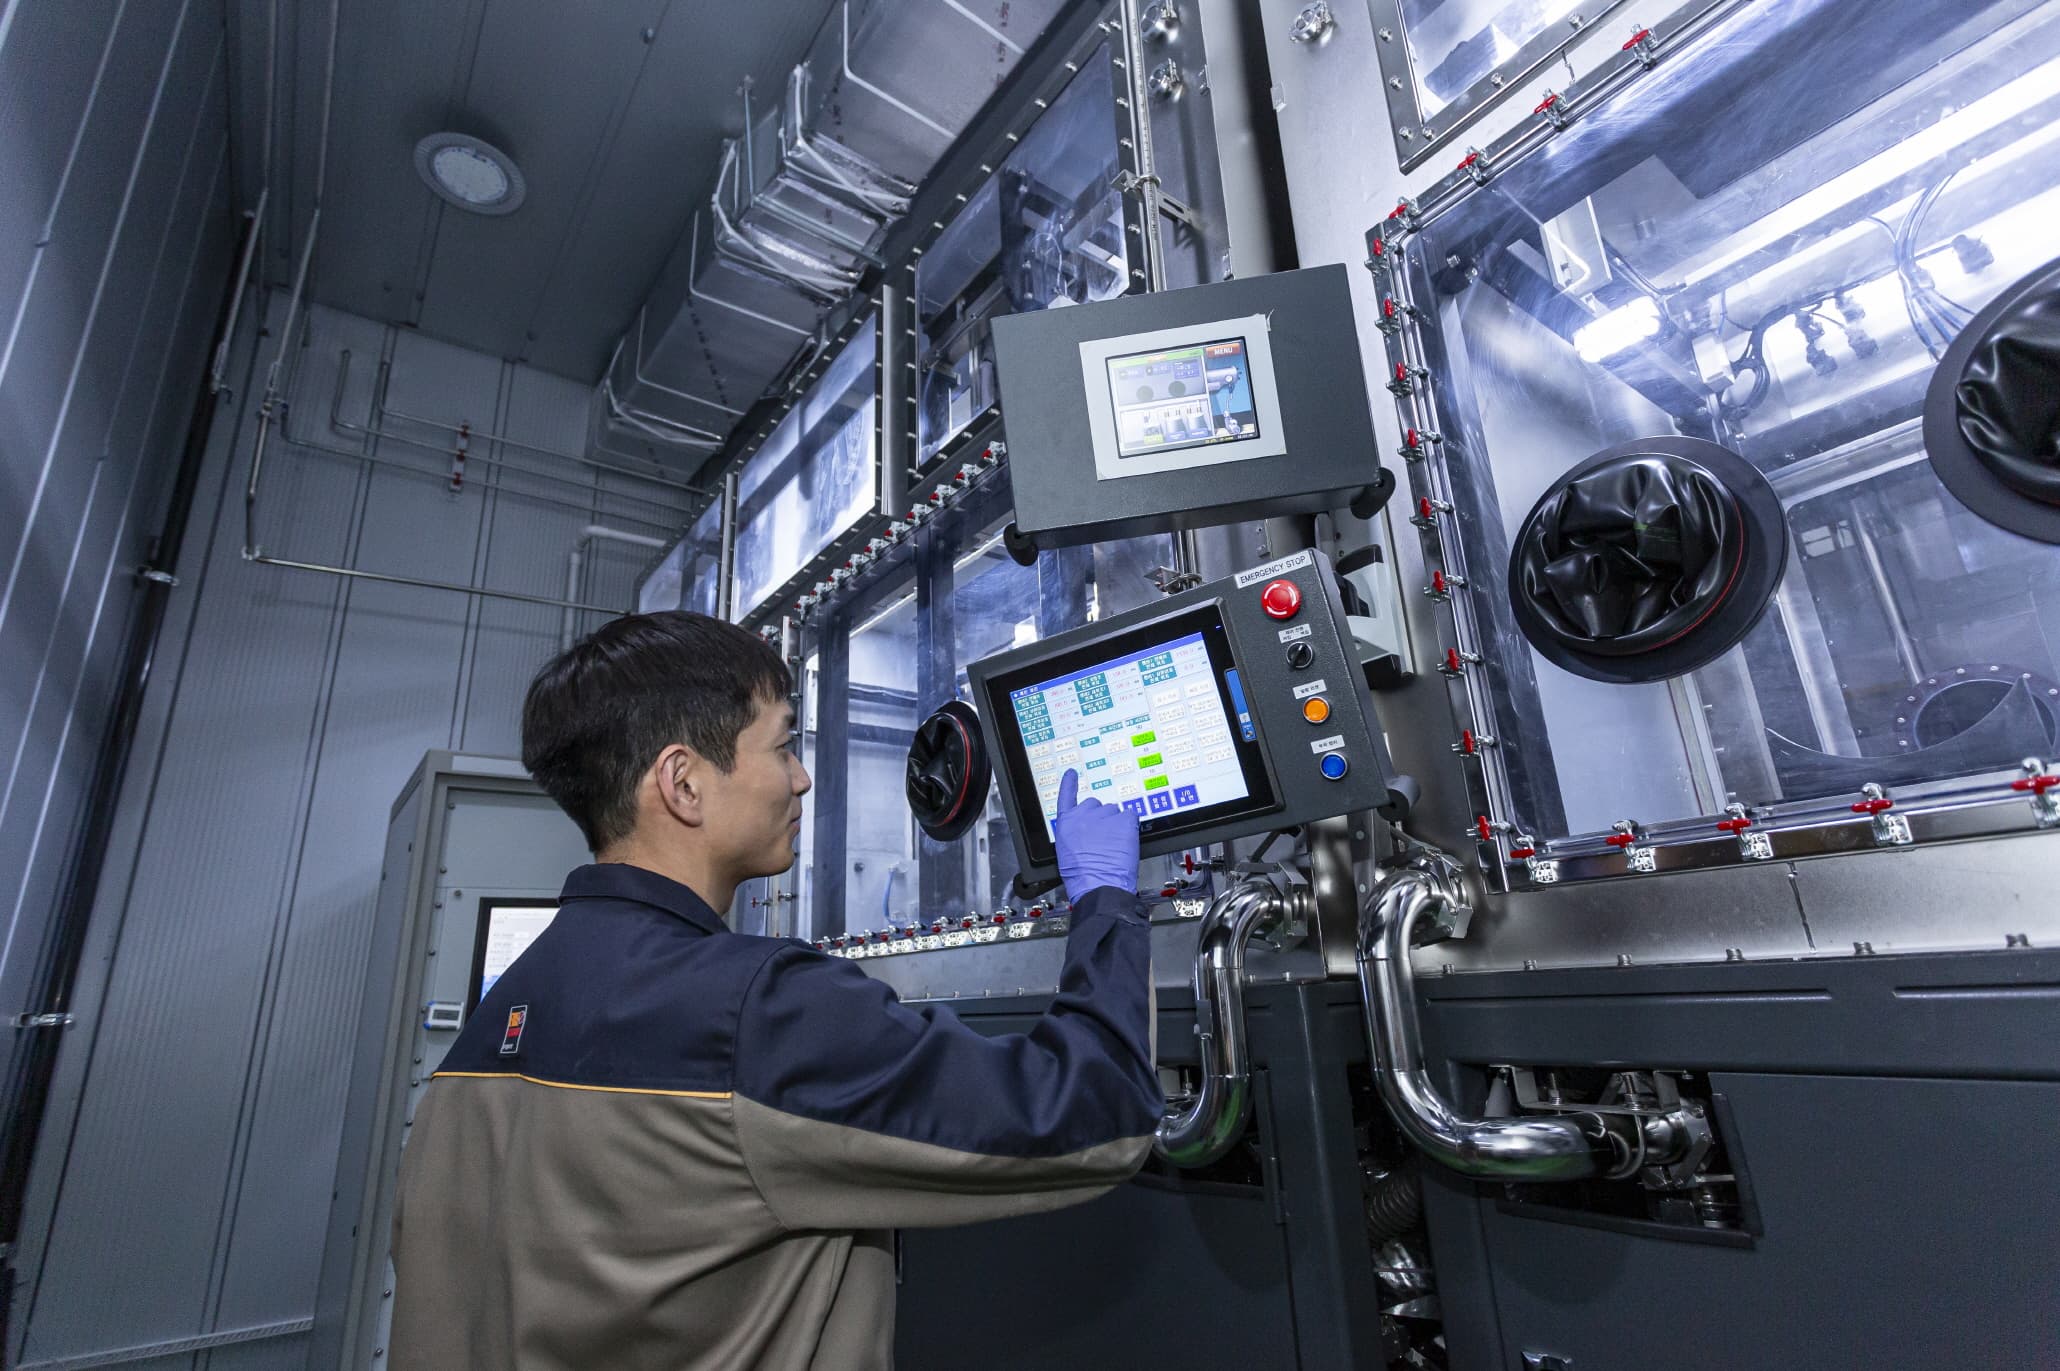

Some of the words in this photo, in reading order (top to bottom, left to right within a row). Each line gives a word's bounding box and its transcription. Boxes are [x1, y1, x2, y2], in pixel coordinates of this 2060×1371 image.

[1214, 346, 1233, 355] MENU
[1240, 563, 1284, 584] EMERGENCY
[1286, 555, 1306, 568] STOP
